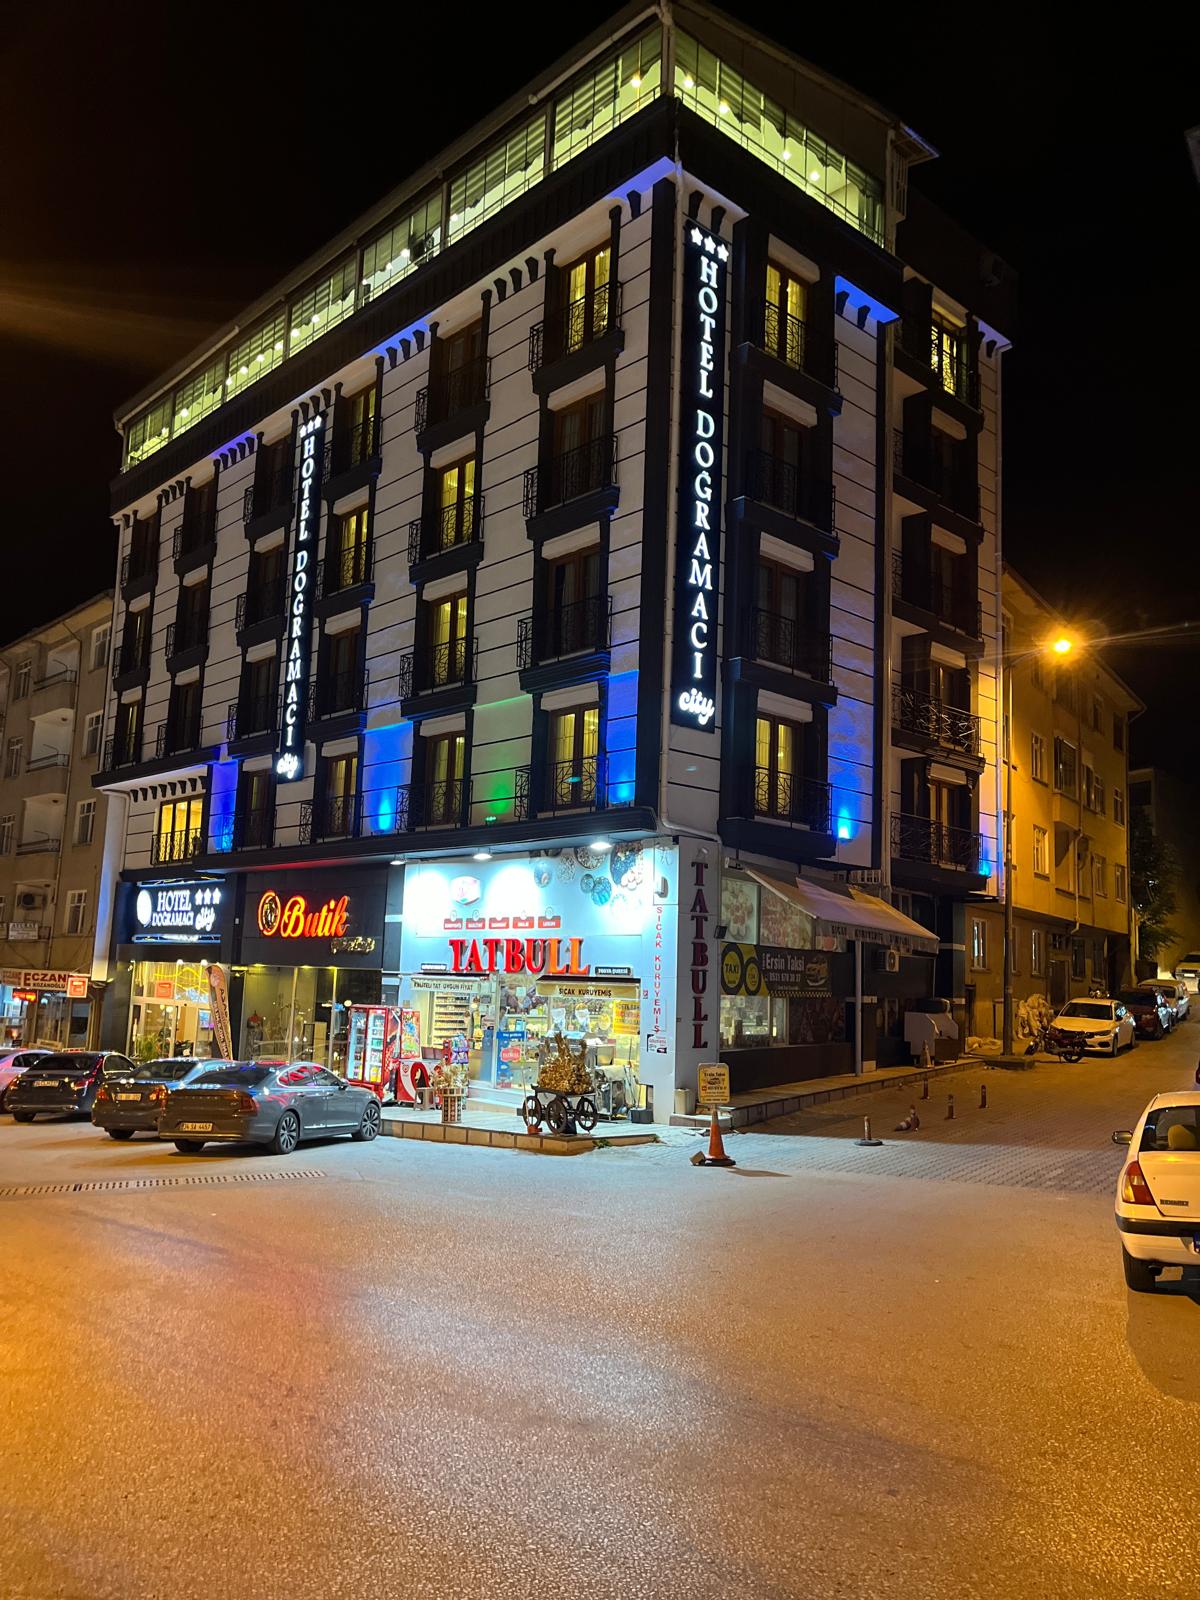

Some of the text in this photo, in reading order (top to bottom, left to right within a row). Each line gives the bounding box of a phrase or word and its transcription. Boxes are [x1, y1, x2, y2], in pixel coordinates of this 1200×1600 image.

[698, 255, 718, 399] HOTEL
[298, 435, 316, 541] HOTEL
[678, 687, 715, 726] city
[157, 889, 192, 912] HOTEL
[280, 895, 350, 938] Butik
[449, 937, 590, 975] TATBULL
[690, 862, 709, 1048] TATBULL
[725, 963, 739, 974] TAXI
[766, 953, 785, 970] Ersin
[787, 954, 805, 971] Taksi
[23, 972, 68, 987] ECZAN
